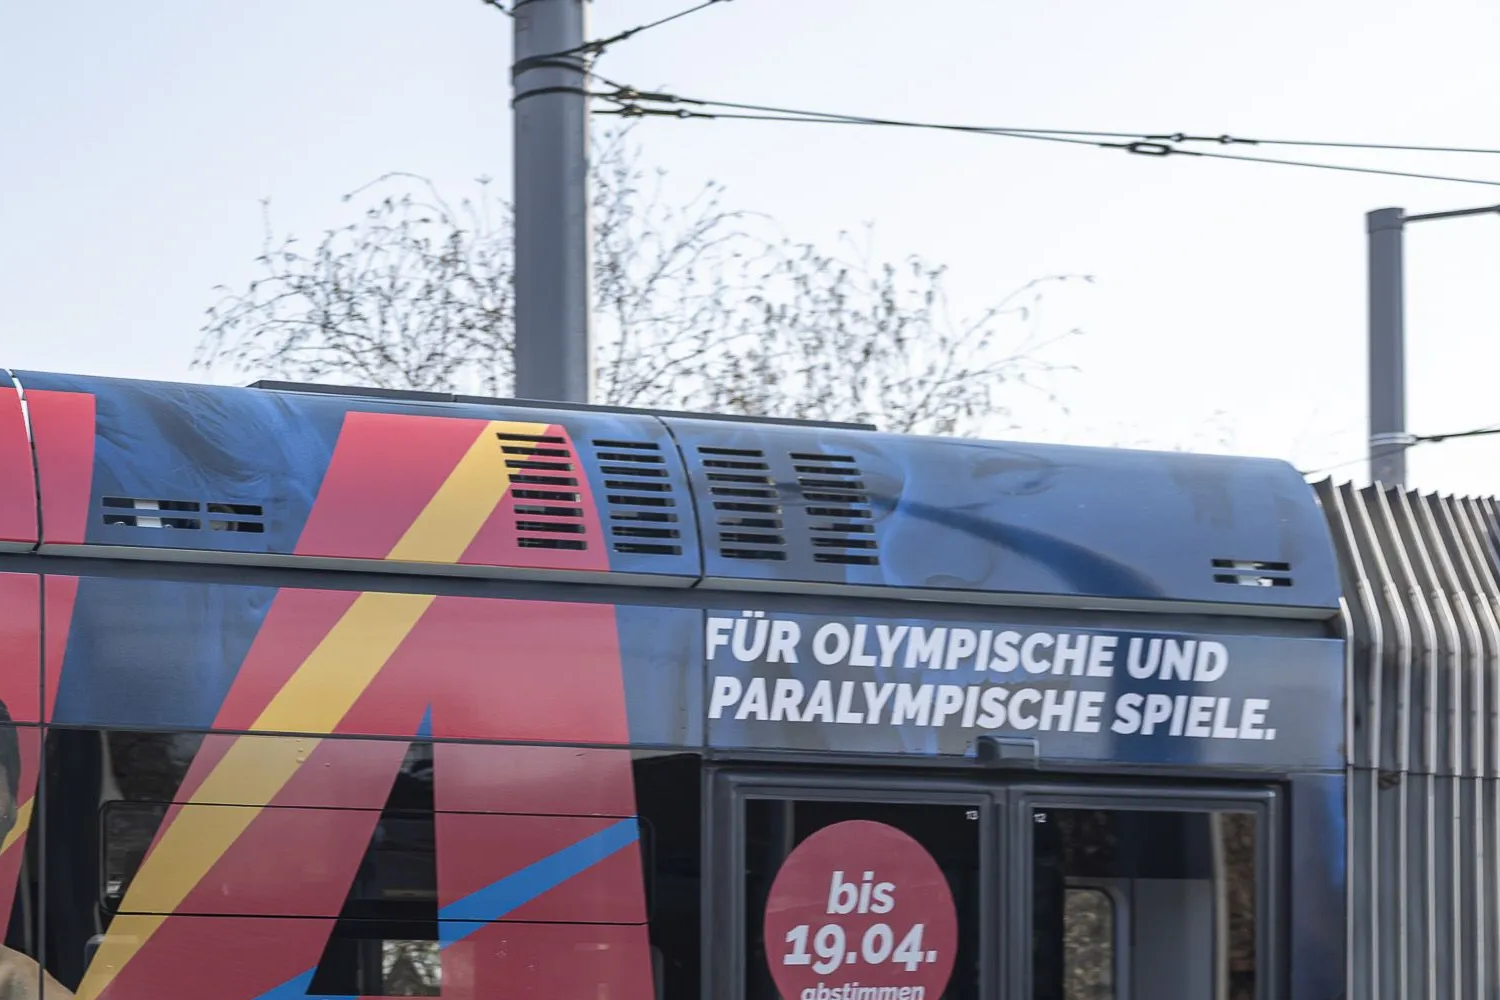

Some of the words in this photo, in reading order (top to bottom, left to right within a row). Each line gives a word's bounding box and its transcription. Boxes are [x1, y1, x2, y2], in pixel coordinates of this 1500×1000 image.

[705, 611, 801, 664] FÜR
[812, 622, 1118, 678] OLYMPISCHE
[1126, 637, 1229, 682] UND
[707, 676, 1106, 733] PARALYMPISCHE
[1111, 692, 1277, 741] SPIELE.
[826, 870, 896, 915] bis
[783, 923, 938, 975] 19.04.
